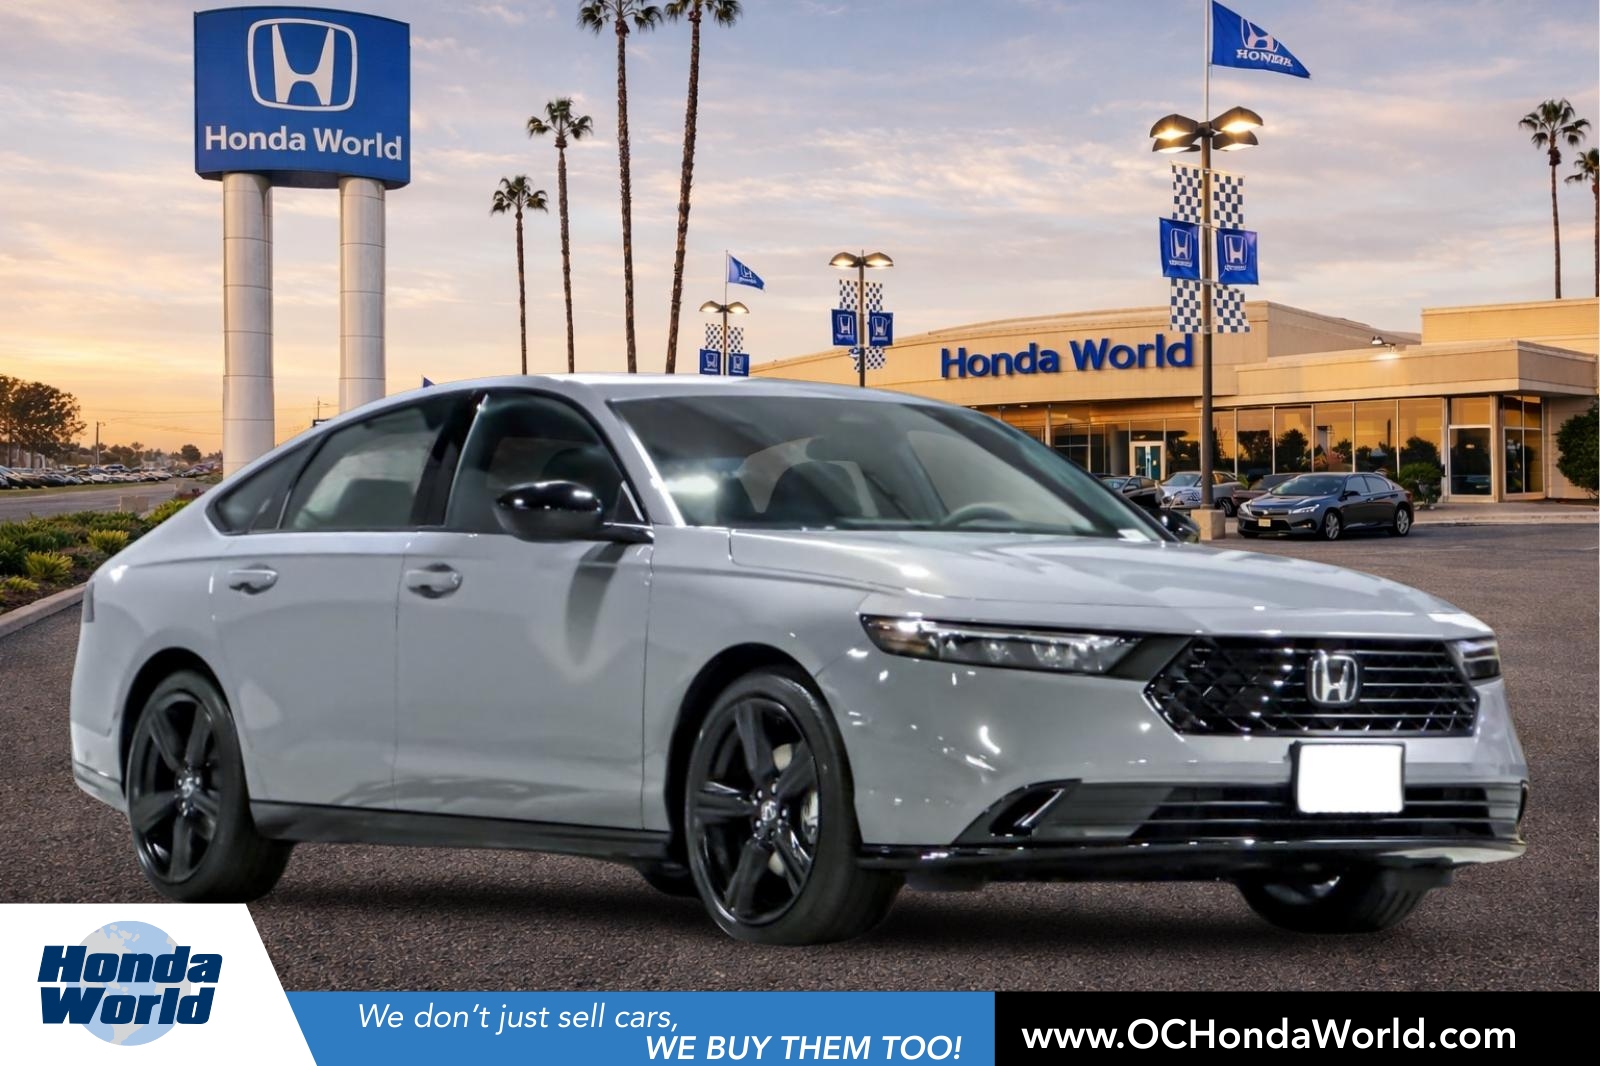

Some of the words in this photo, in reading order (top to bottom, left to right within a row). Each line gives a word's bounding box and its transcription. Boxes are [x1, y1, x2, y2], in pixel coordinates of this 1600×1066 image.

[205, 125, 306, 151] Honda
[312, 127, 402, 161] World
[941, 342, 1061, 378] Honda
[1069, 333, 1194, 371] World
